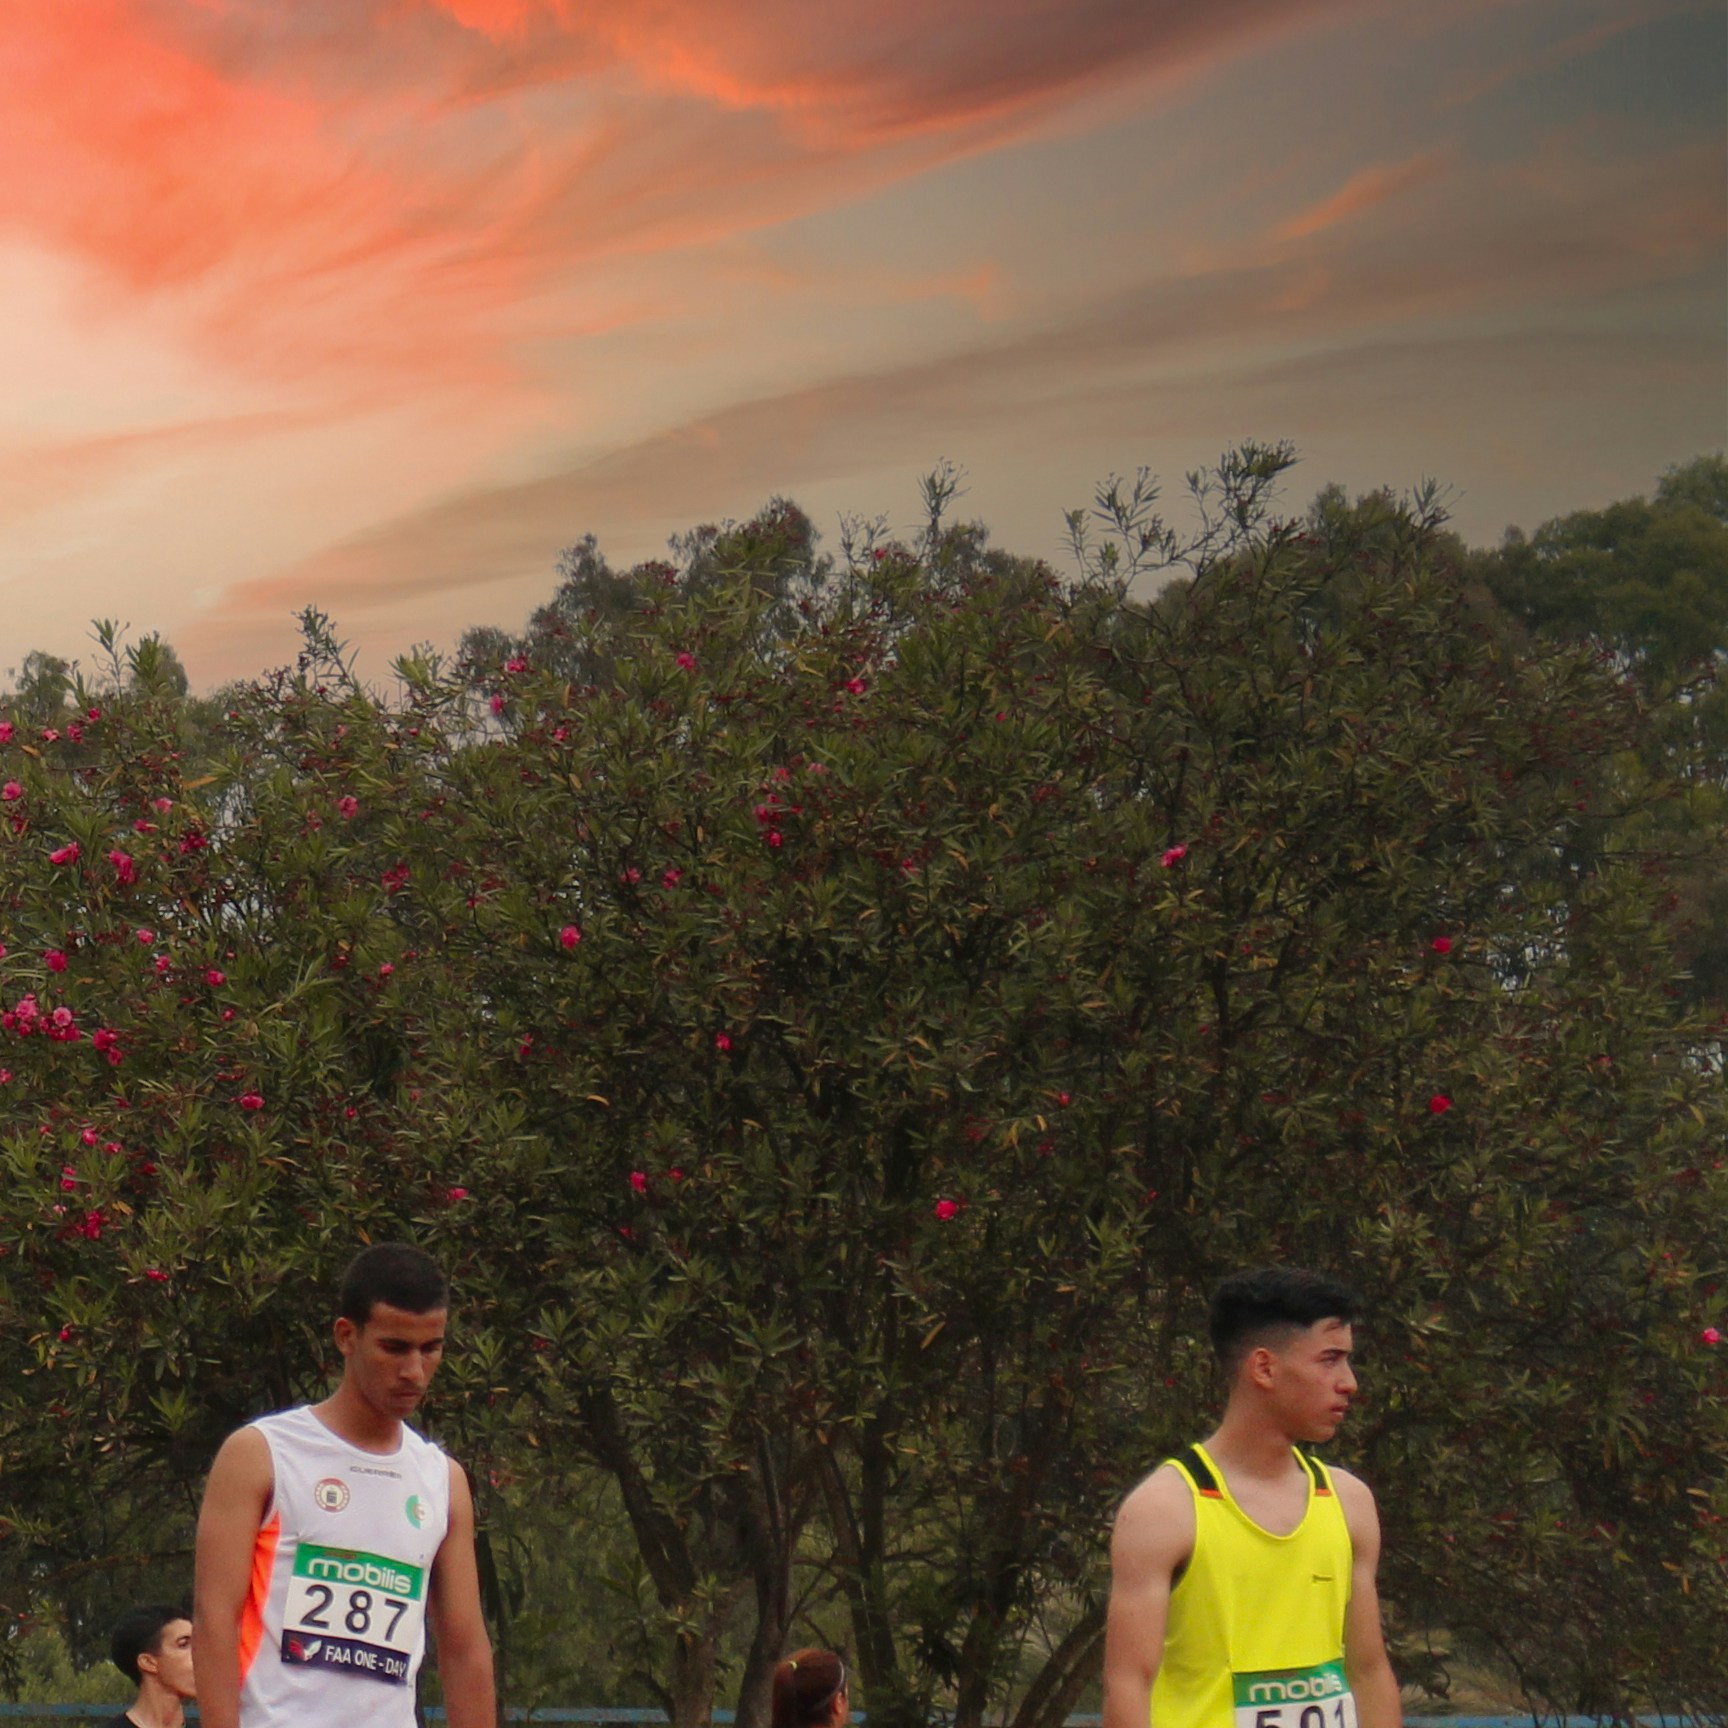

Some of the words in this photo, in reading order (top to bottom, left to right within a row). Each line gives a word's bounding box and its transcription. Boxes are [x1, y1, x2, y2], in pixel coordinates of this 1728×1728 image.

[308, 1558, 412, 1595] mobilis
[299, 1584, 409, 1642] 287
[325, 1646, 351, 1664] FAA
[354, 1650, 378, 1670] ONE
